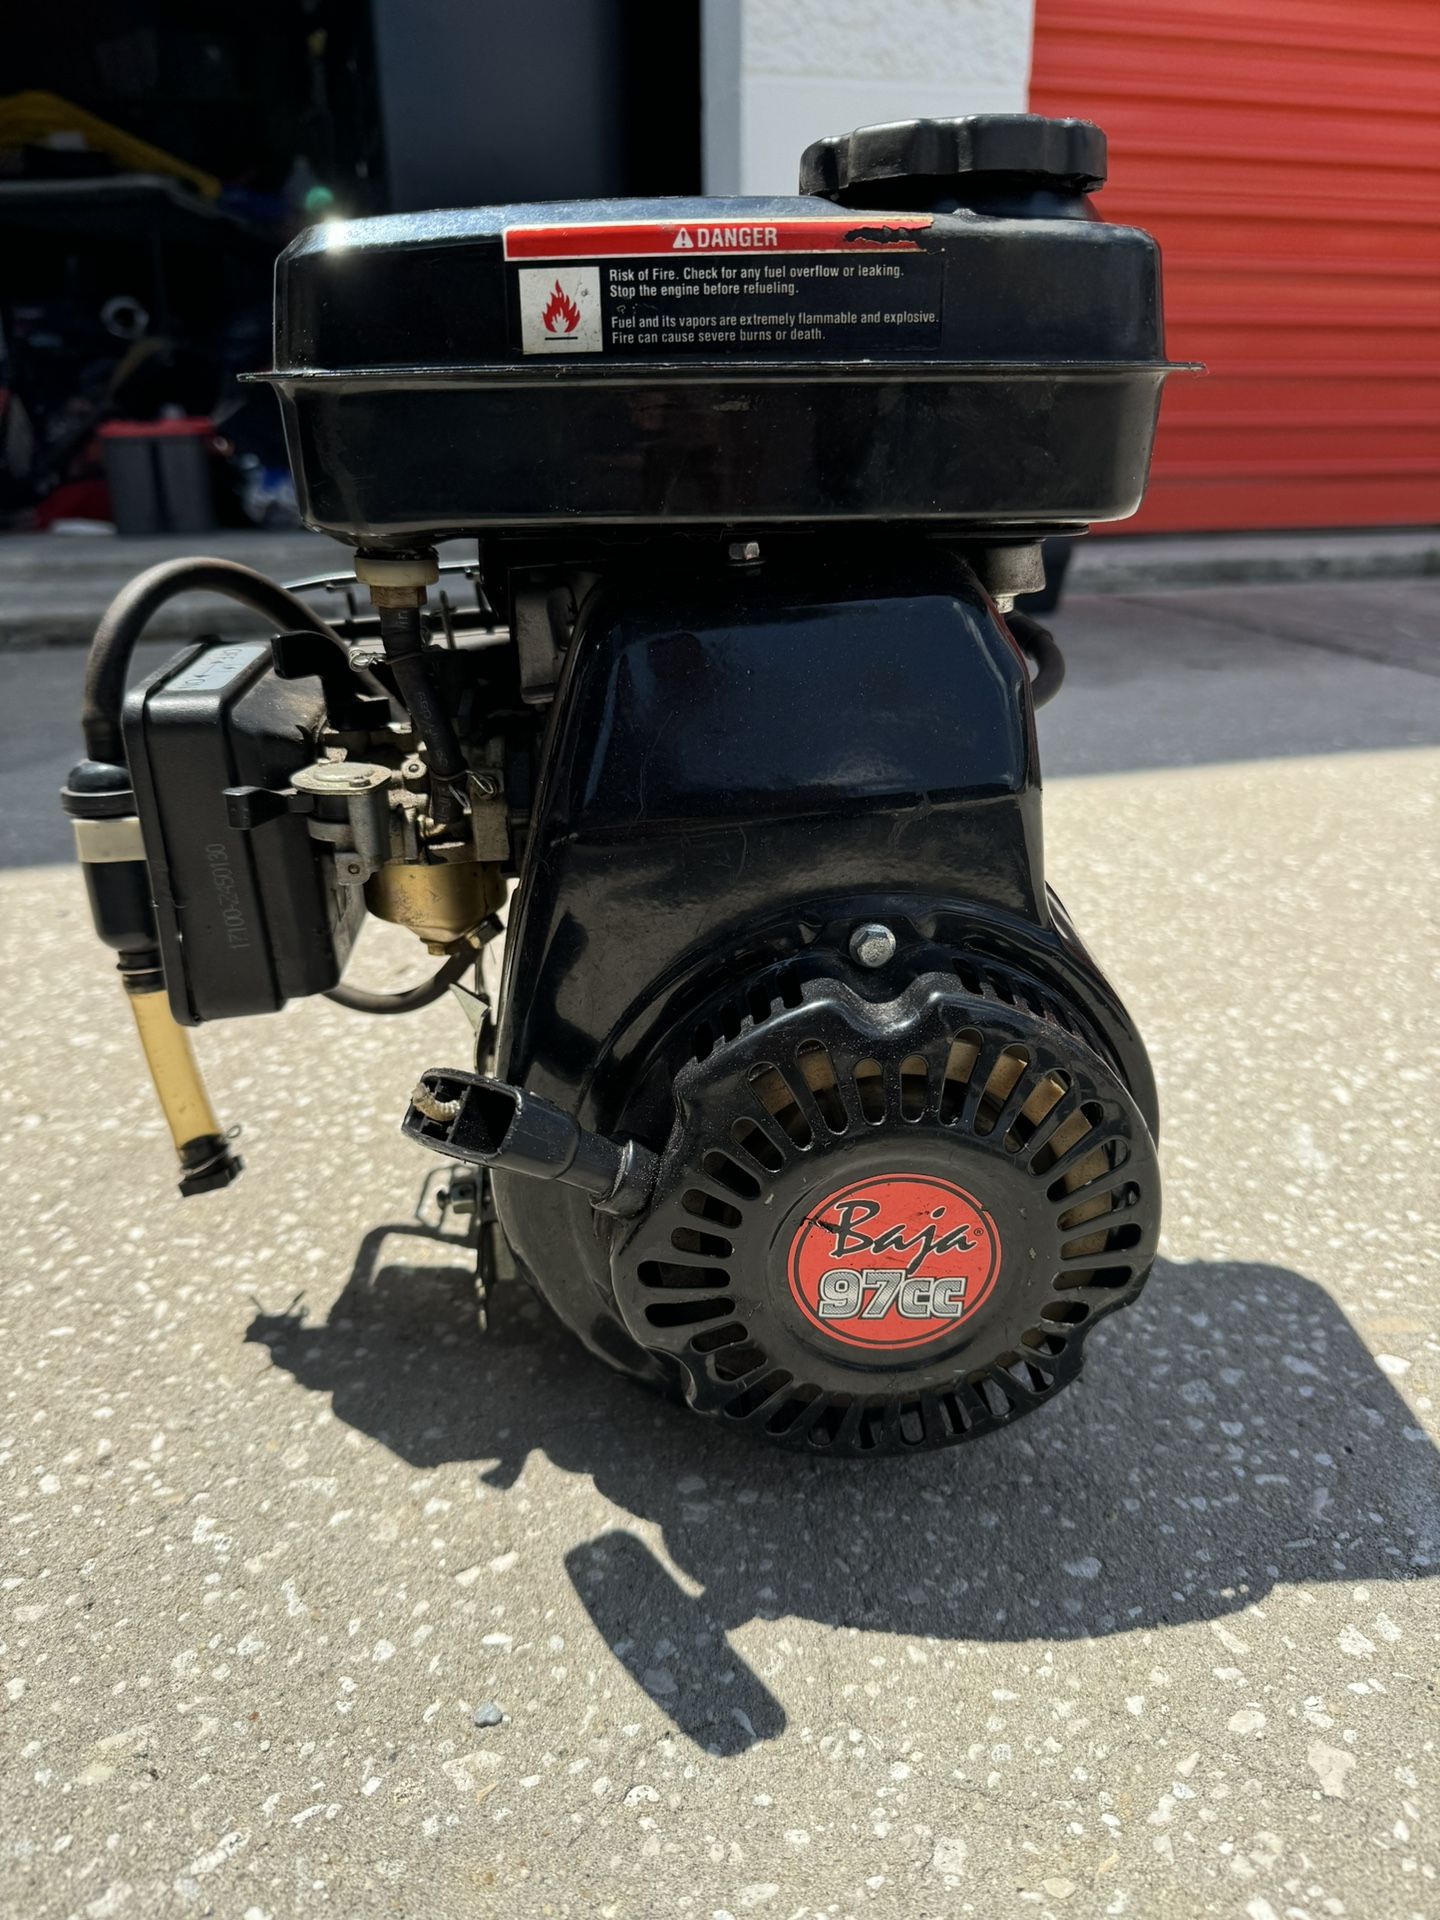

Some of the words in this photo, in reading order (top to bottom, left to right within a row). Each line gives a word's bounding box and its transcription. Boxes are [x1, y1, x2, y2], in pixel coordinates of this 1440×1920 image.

[697, 227, 778, 248] DANGER
[609, 269, 635, 282] Risk
[638, 268, 649, 281] of
[652, 268, 680, 281] Fire.
[683, 267, 718, 280] Check
[721, 266, 737, 279] for
[740, 267, 761, 281] any
[764, 265, 786, 278] fuel
[790, 265, 839, 277] overflow
[842, 266, 855, 277] or
[858, 264, 905, 279] leaking.
[610, 285, 636, 299] Stop
[639, 284, 657, 297] the
[661, 283, 700, 298] engine
[703, 283, 740, 296] before
[744, 282, 799, 296] refueling.
[611, 316, 636, 329] Fuel
[639, 315, 659, 328] and
[661, 315, 676, 327] its
[679, 316, 717, 329] vapors
[719, 316, 737, 326] are
[740, 312, 795, 327] extremely
[799, 311, 857, 325] flammable
[860, 311, 881, 323] and
[883, 310, 939, 325] explosive.
[612, 331, 634, 344] Fire
[638, 332, 658, 343] can
[661, 331, 695, 342] cause
[698, 330, 736, 342] severe
[740, 329, 772, 341] burns
[775, 330, 787, 341] or
[790, 328, 826, 340] death.
[829, 1199, 977, 1276] Baja
[818, 1267, 969, 1320] 97cc
